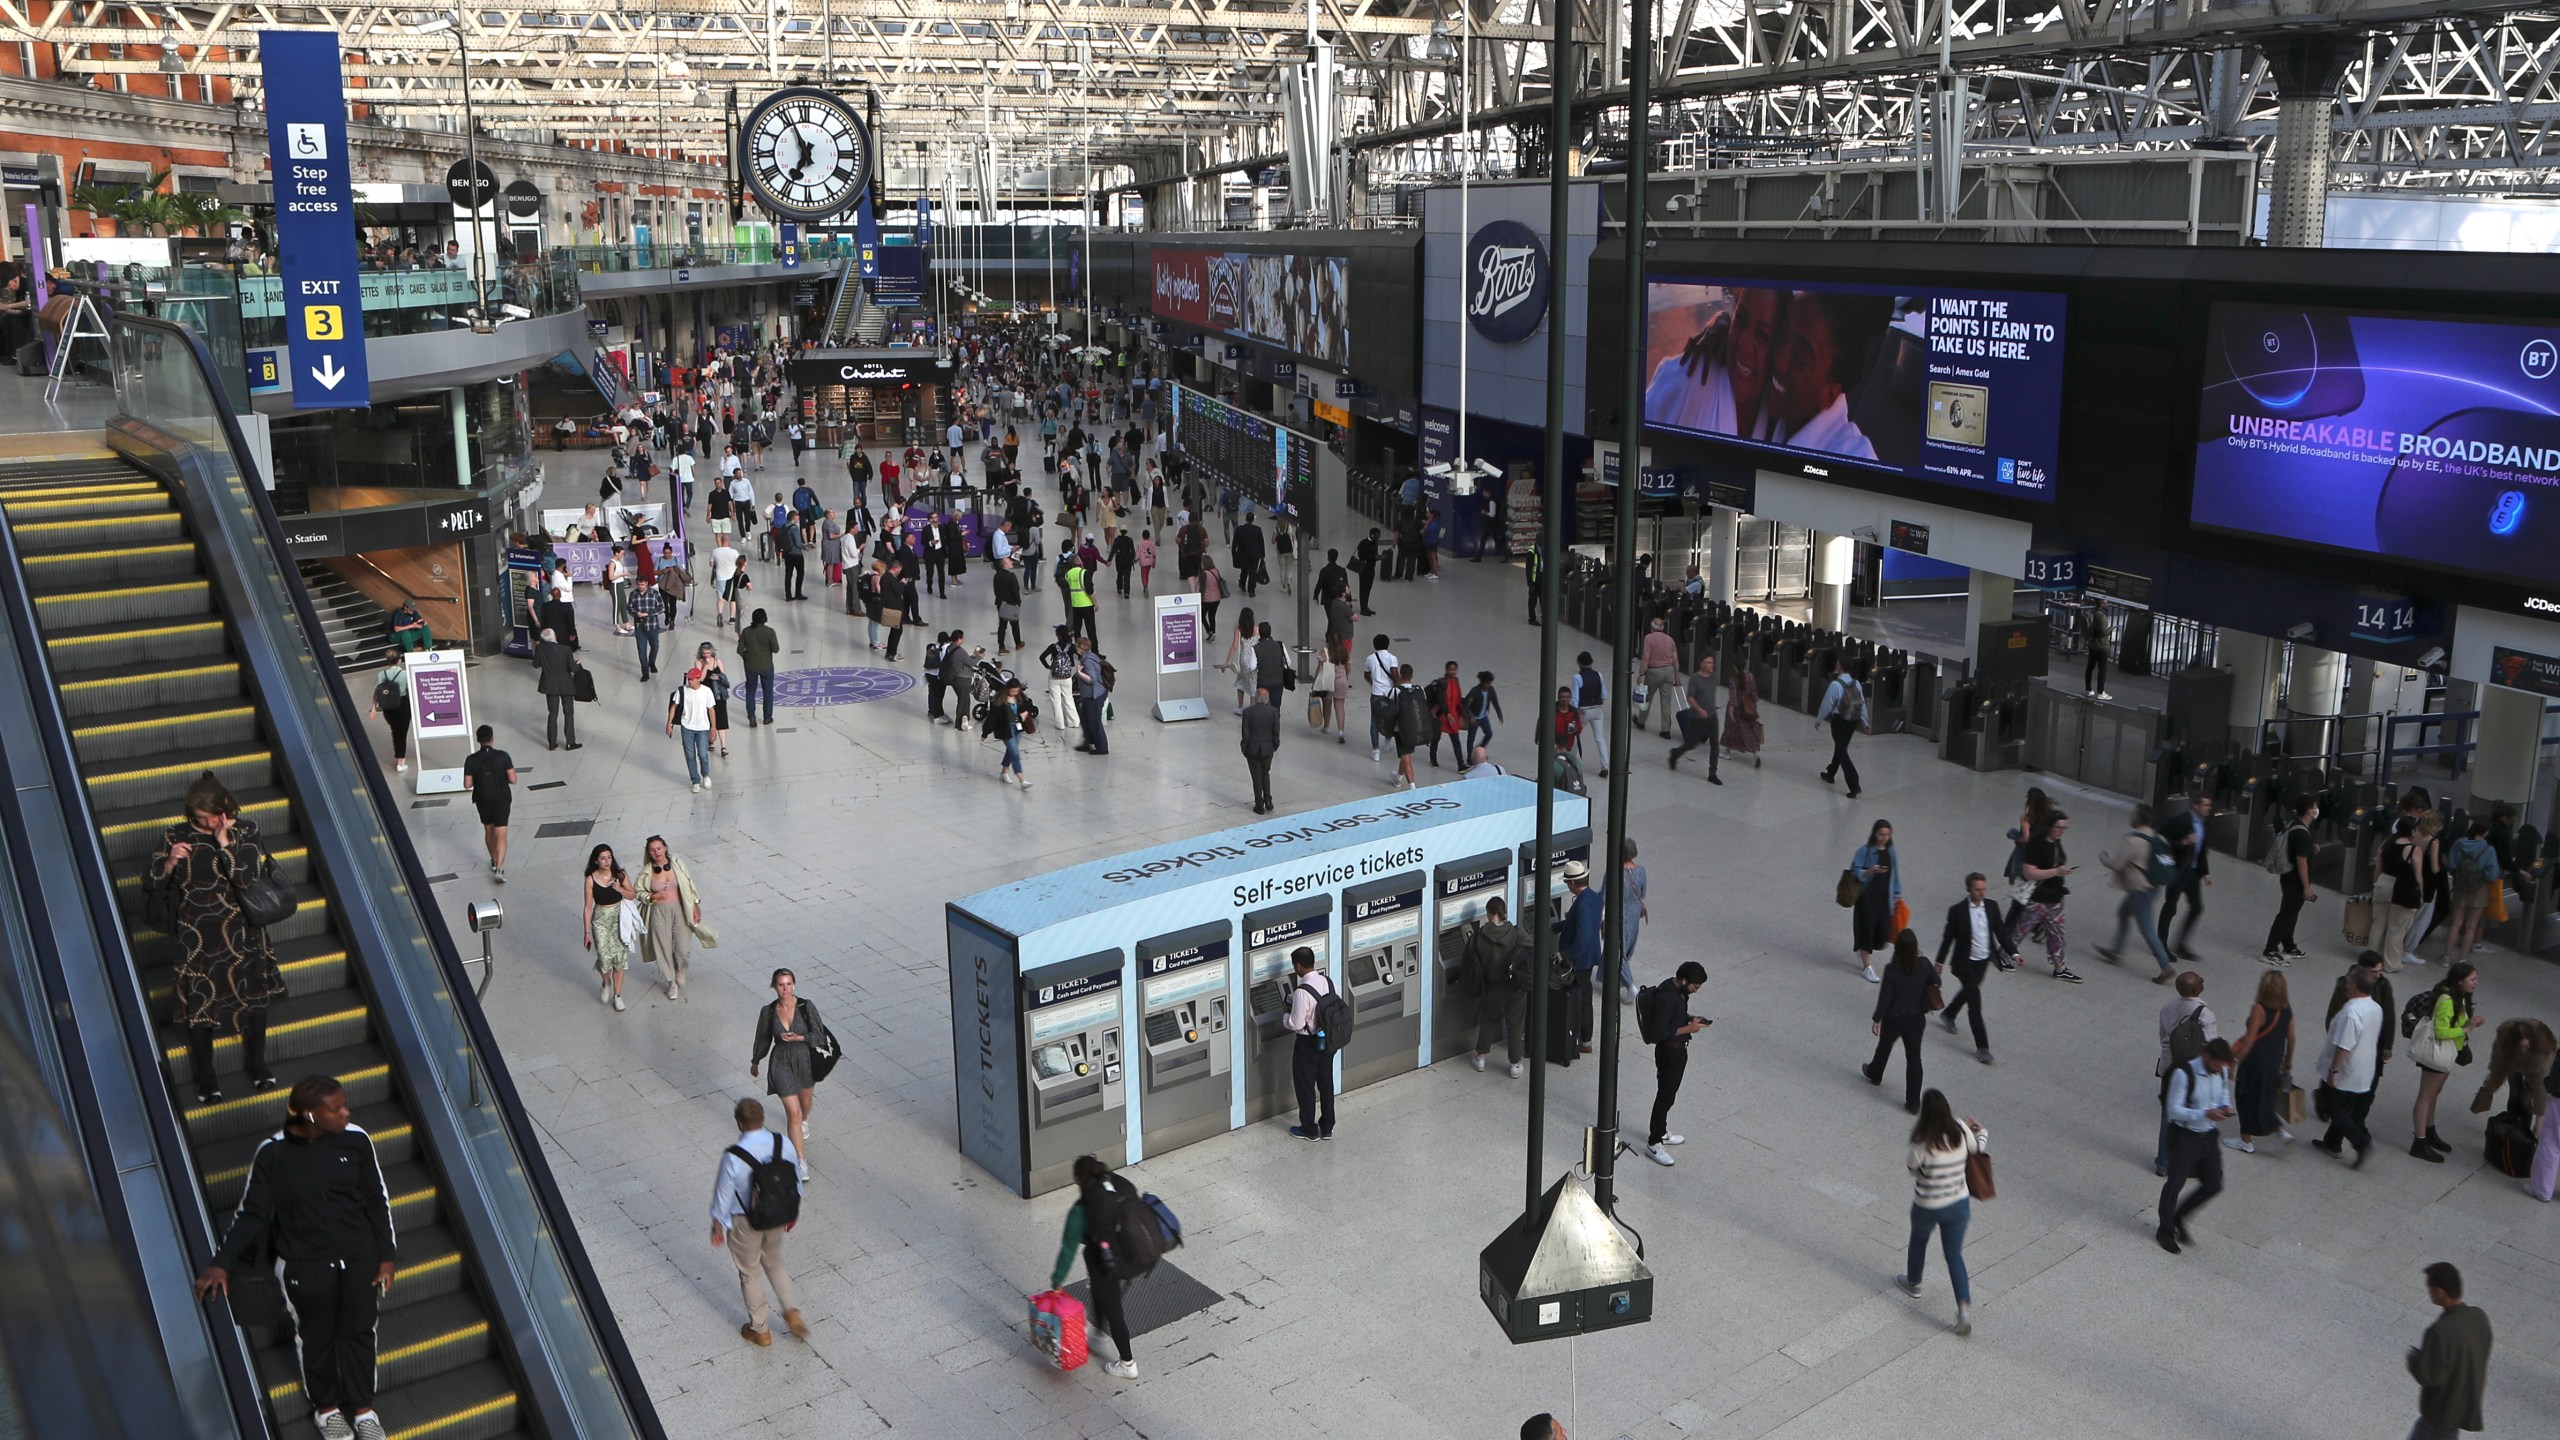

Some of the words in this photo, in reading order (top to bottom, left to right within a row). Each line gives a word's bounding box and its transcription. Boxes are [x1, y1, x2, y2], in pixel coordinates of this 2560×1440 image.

[4, 172, 20, 180] Waterloo
[292, 166, 328, 181] Step
[296, 182, 327, 196] free
[451, 179, 489, 187] BENGO
[288, 201, 338, 212] access
[301, 280, 340, 295] EXIT
[1156, 261, 1172, 310] Quality
[1173, 263, 1200, 310] ingredients
[1470, 245, 1535, 318] Boots
[240, 291, 256, 304] TEA
[263, 290, 284, 303] SAND
[360, 286, 379, 298] ETTES
[385, 284, 404, 296] WRAPS
[410, 283, 426, 295] CAKES
[431, 281, 448, 293] SALADS
[452, 280, 463, 292] BEER
[1932, 298, 1936, 314] I
[1940, 298, 1978, 317] WANT
[1981, 300, 2008, 319] THE
[314, 309, 333, 336] 3
[1931, 317, 1979, 336] POINTS
[1983, 320, 1988, 337] I
[1991, 321, 2030, 340] EARN
[2034, 324, 2054, 342] TO
[1193, 336, 1199, 344] 8
[1930, 335, 1964, 354] TAKE
[1967, 338, 1985, 357] US
[1988, 340, 2030, 360] HERE.
[2267, 338, 2277, 347] BT
[1230, 348, 1237, 356] 9
[2528, 352, 2550, 367] BT
[265, 366, 273, 378] 3
[1279, 364, 1292, 374] 10
[1929, 364, 1950, 375] Search
[1955, 366, 1974, 377] Amex
[1974, 368, 1990, 379] Gold
[1341, 383, 1356, 394] 11
[1424, 419, 1450, 434] welcome
[1424, 436, 1442, 447] pharmacy
[2229, 414, 2395, 452] UNBREAKABLE
[2399, 432, 2560, 471] BROADBAND
[2228, 436, 2248, 449] Only
[2249, 438, 2267, 450] BT's
[2269, 441, 2298, 455] Hybrid
[2300, 445, 2350, 460] Broadband
[2352, 451, 2359, 461] is
[2361, 452, 2396, 467] backed
[2397, 459, 2411, 469] up
[2412, 458, 2424, 471] by
[2425, 461, 2443, 474] EE,
[2444, 463, 2462, 475] the
[2464, 465, 2488, 477] UK's
[2489, 467, 2513, 481] best
[2514, 472, 2559, 487] network
[1803, 464, 1829, 477] JCDecaux
[1960, 467, 1972, 477] APR
[2017, 466, 2032, 480] live
[2032, 467, 2046, 483] life
[1642, 473, 1653, 488] 12
[1657, 473, 1675, 489] 12
[2017, 479, 2037, 488] WITHOUT
[450, 508, 474, 532] PRET
[295, 533, 328, 544] Station
[2028, 559, 2046, 580] 13
[2053, 561, 2074, 581] 13
[2357, 604, 2386, 630] 14
[2393, 607, 2414, 631] 14
[1244, 797, 1463, 849] Self-service
[1550, 849, 1567, 860] KETS
[1102, 846, 1247, 884] tickets
[1233, 863, 1355, 908] Self-service
[1360, 845, 1425, 877] tickets
[1459, 871, 1484, 884] TICKETS
[1459, 883, 1469, 891] Cash
[1469, 881, 1477, 889] and
[1370, 894, 1397, 907] TICKETS
[1370, 907, 1381, 915] Card
[1381, 902, 1401, 914] Payments
[1265, 921, 1297, 935] TICKETS
[1265, 935, 1278, 943] Card
[1278, 928, 1302, 941] Payments
[1168, 946, 1199, 960] TICKETS
[1168, 960, 1182, 969] Card
[1182, 955, 1204, 967] Payments
[1056, 977, 1089, 991] TICKETS
[1056, 991, 1069, 1000] Cash
[1070, 989, 1079, 998] and
[1080, 986, 1092, 995] Card
[1093, 979, 1118, 993] Payments
[975, 954, 993, 1071] TICKETS
